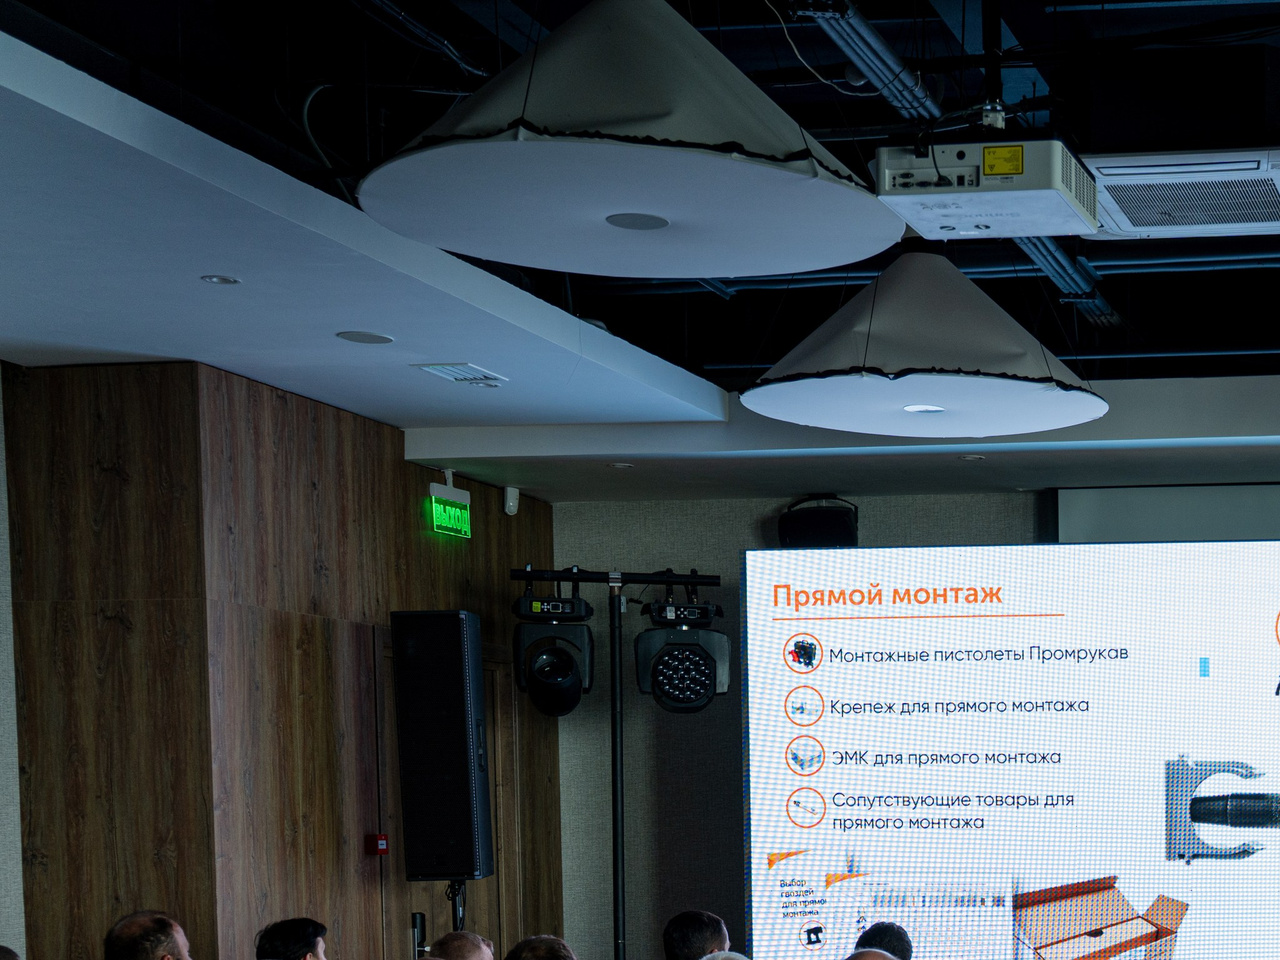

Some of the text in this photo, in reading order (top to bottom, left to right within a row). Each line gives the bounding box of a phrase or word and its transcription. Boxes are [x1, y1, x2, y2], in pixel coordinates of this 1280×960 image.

[434, 503, 469, 536] ВЫХОД
[773, 582, 1002, 612] Прямой монтаж
[829, 645, 1129, 663] Монтажные пистолеты Промрукав
[830, 699, 1090, 717] Крепеж для прямого монтажа
[832, 751, 1062, 768] ЭМК для прямого монтажа
[832, 792, 1074, 810] Сопутствующие товары для
[833, 817, 985, 832] прямого монтажа
[780, 878, 806, 888] Выбор
[780, 887, 814, 898] гвоздей
[782, 901, 798, 909] для
[782, 909, 819, 918] монтажа
